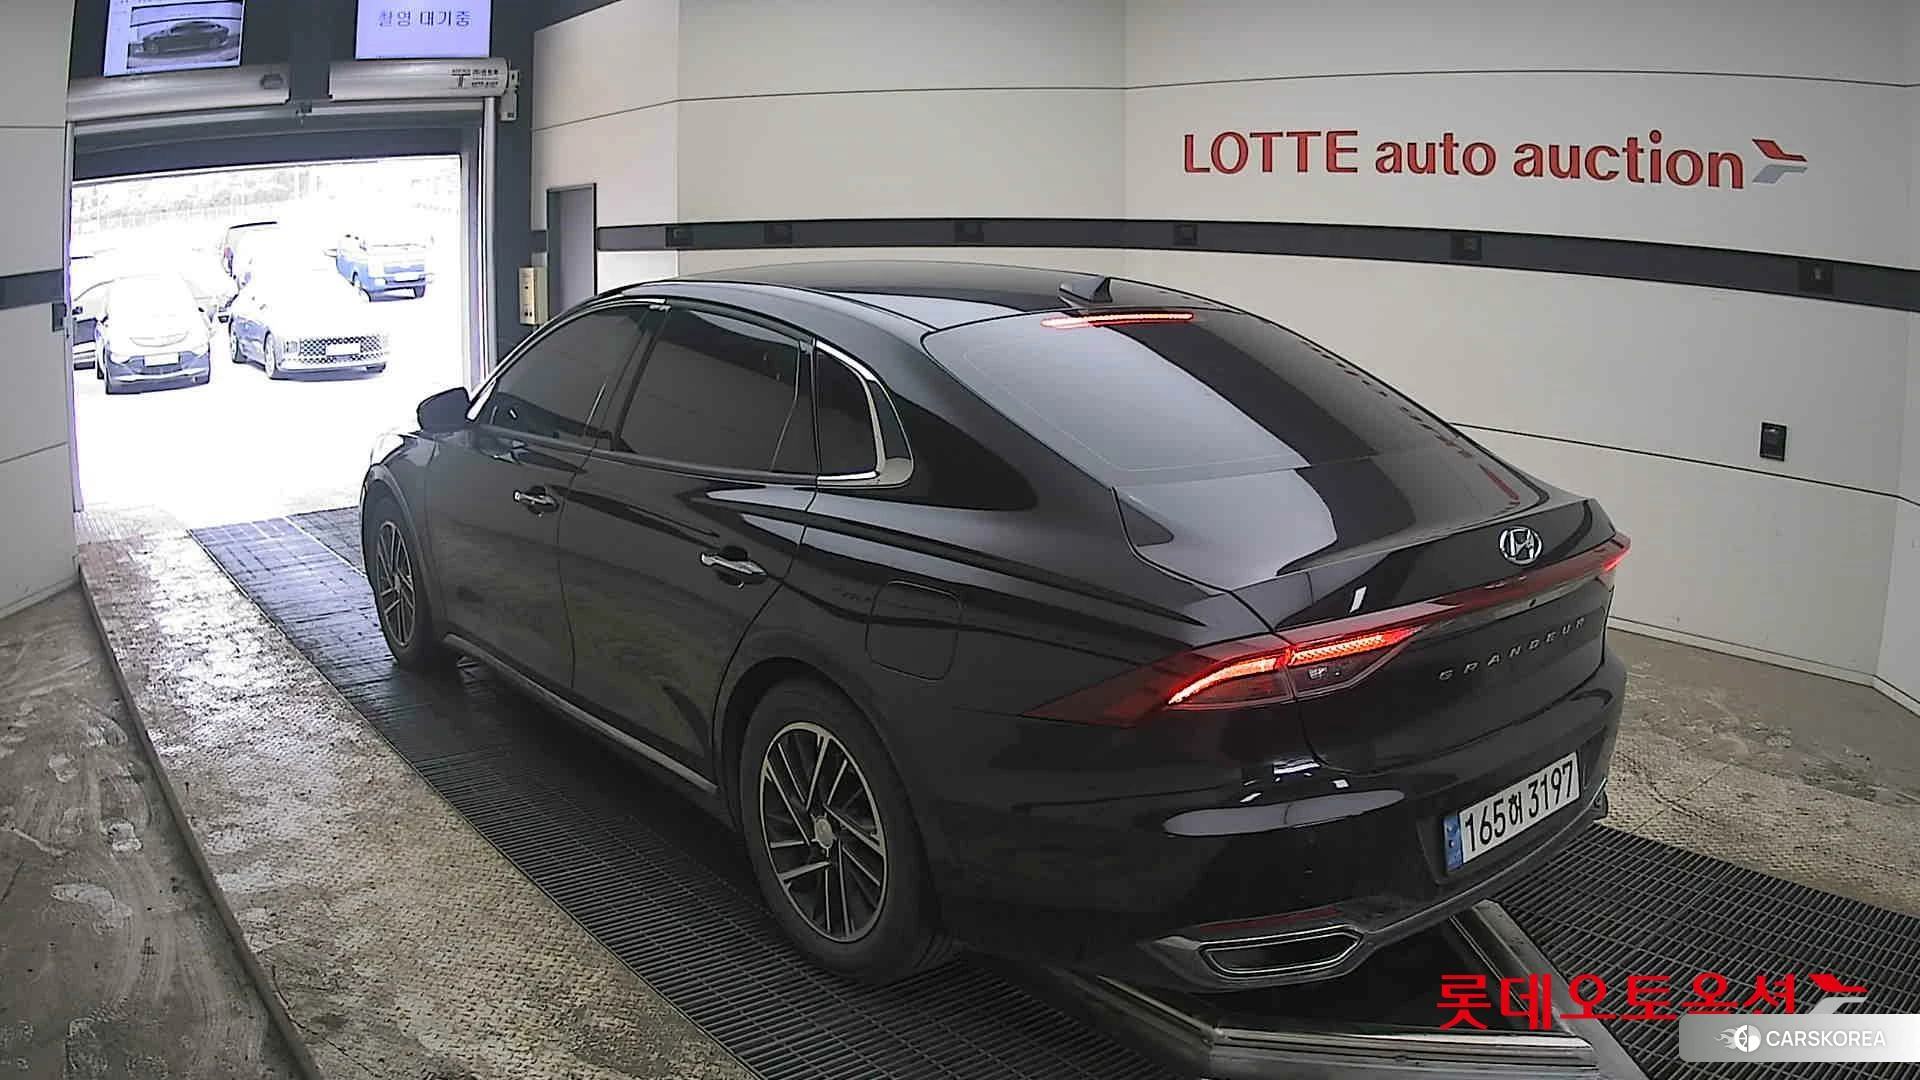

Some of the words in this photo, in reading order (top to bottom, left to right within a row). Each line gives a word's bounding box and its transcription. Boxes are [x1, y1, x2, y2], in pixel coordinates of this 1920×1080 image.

[420, 10, 471, 27] 대기중
[1184, 130, 1358, 174] LOTTE
[1375, 132, 1497, 176] auto
[1513, 129, 1744, 189] auction
[1439, 617, 1585, 680] GRANDEUR
[1465, 791, 1523, 851] 165허
[1528, 760, 1573, 818] 3197
